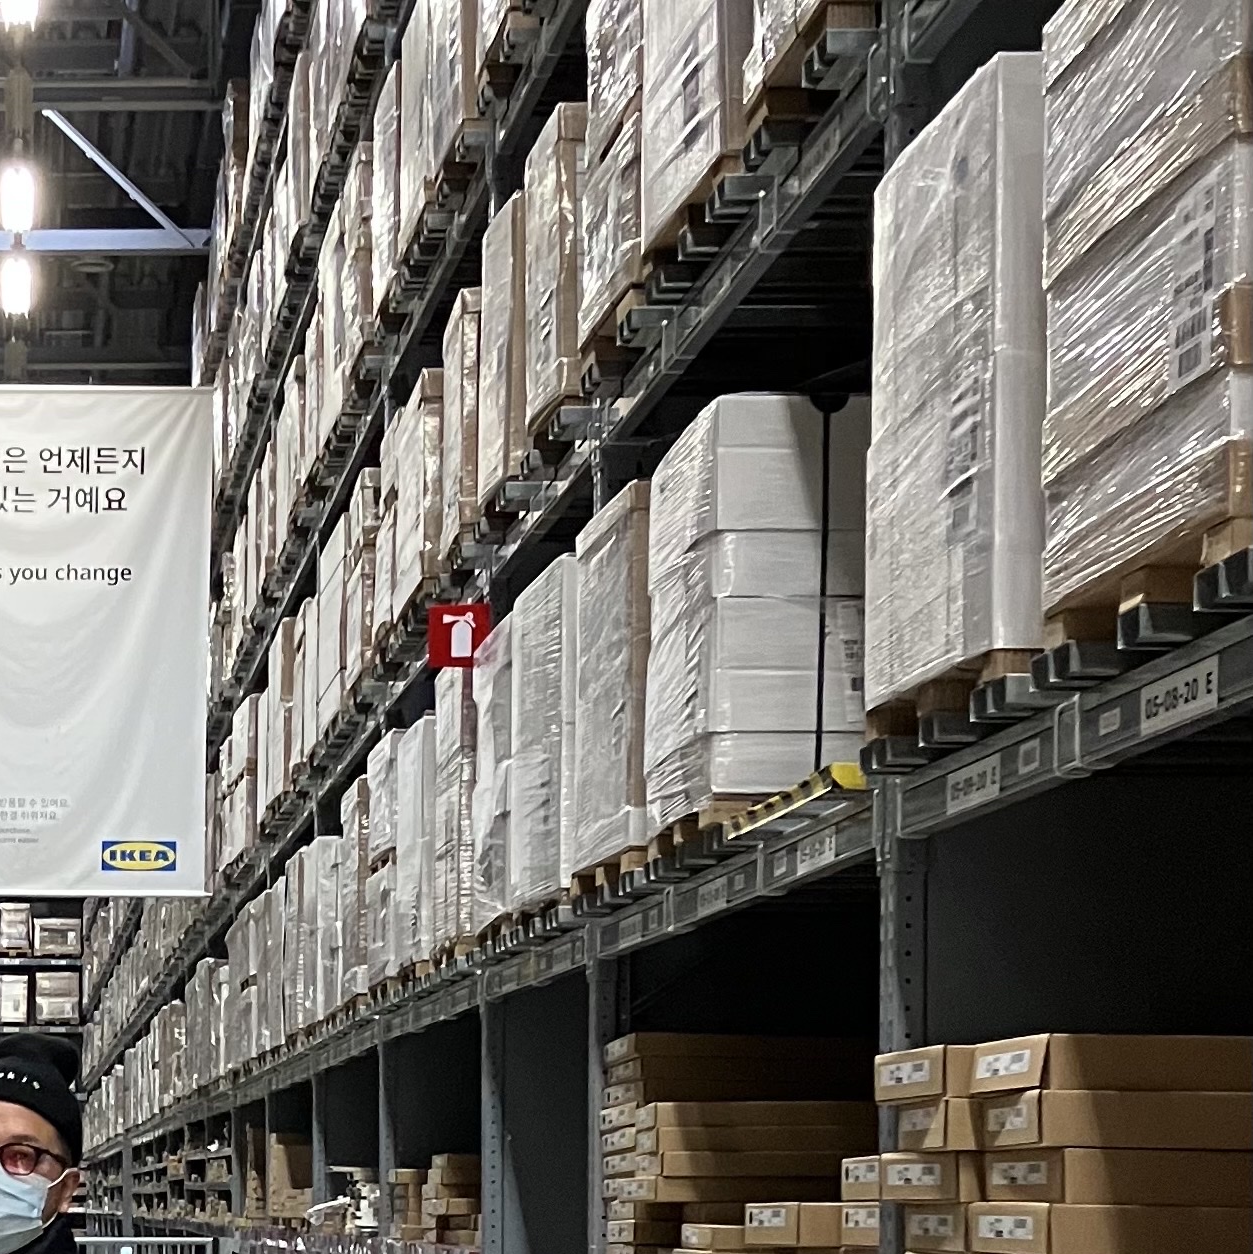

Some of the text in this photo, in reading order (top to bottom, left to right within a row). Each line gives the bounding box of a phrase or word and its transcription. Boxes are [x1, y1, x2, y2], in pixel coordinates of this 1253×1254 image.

[39, 446, 146, 475] 언제든지
[47, 486, 128, 514] 거예요
[9, 566, 48, 585] you
[55, 562, 133, 586] change
[1206, 671, 1213, 694] E
[110, 849, 170, 862] IKEA
